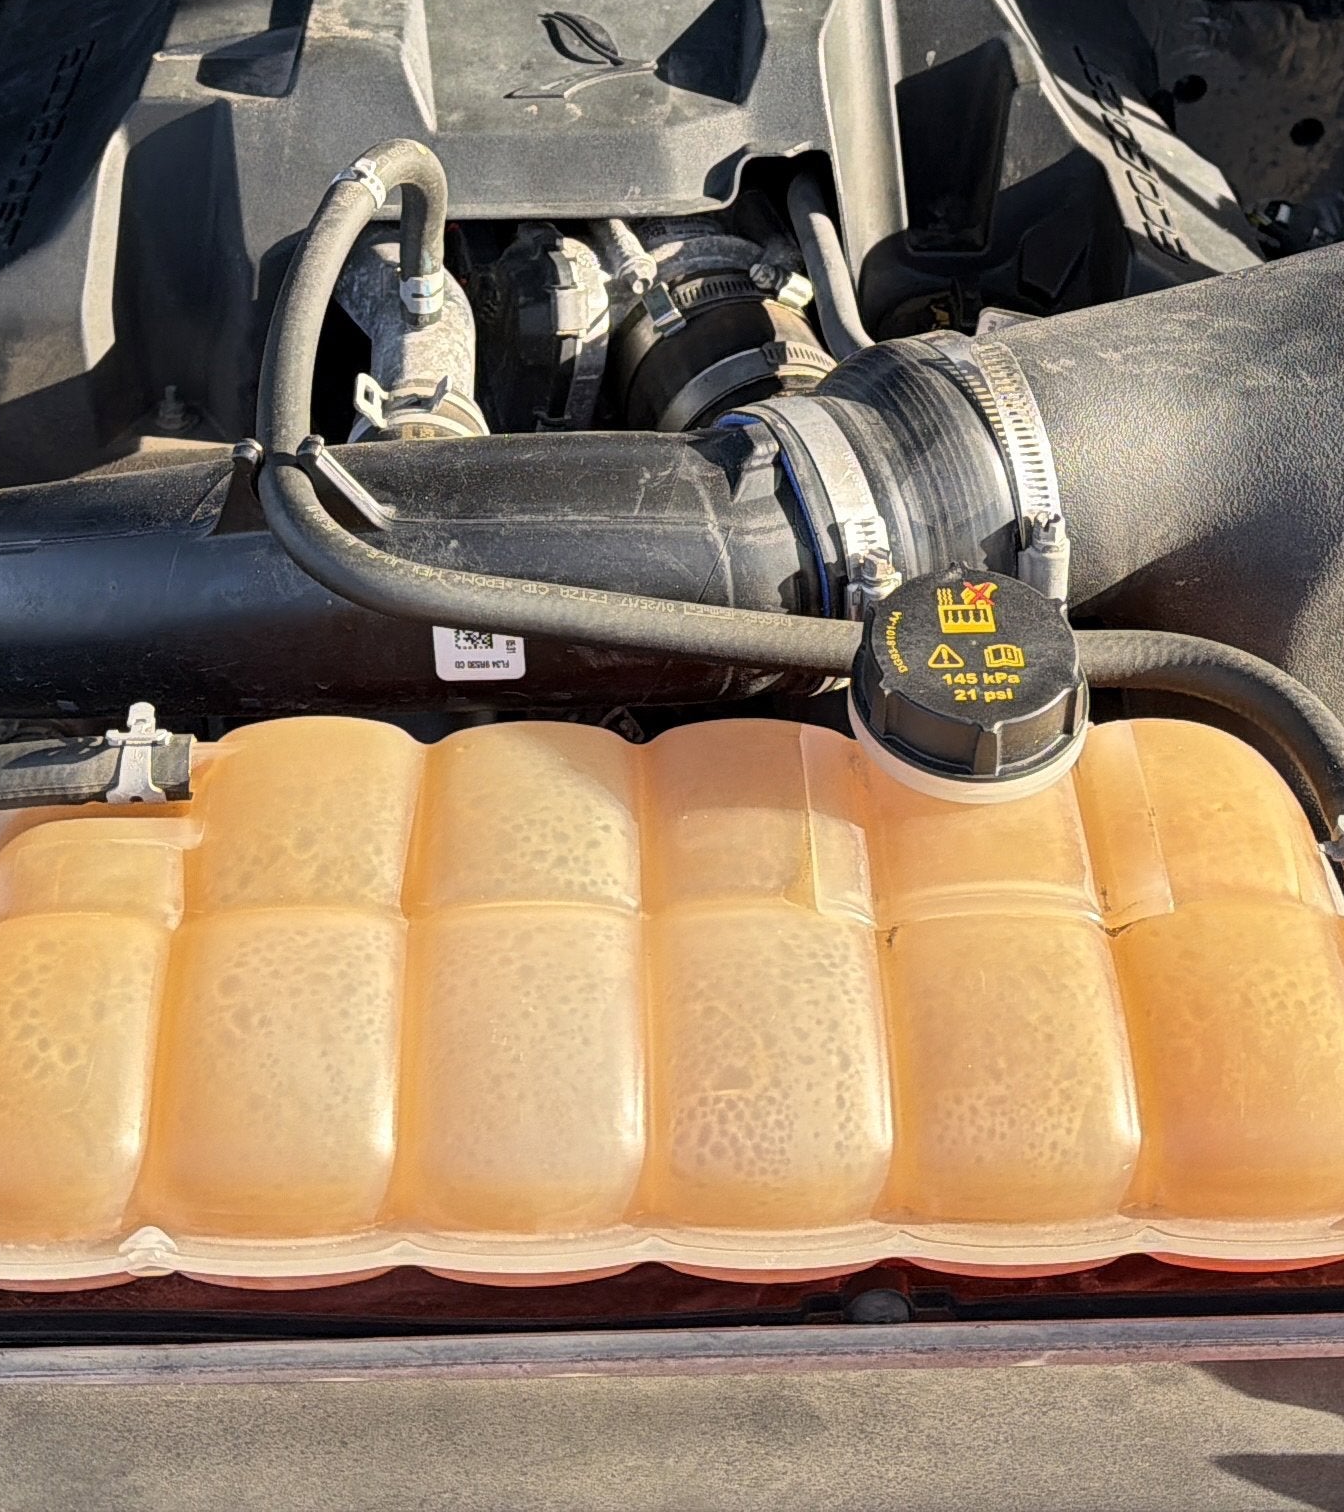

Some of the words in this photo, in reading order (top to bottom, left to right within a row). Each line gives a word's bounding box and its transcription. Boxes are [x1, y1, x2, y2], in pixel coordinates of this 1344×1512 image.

[942, 672, 979, 686] 145
[983, 671, 1021, 686] kPa
[953, 689, 977, 702] 21
[984, 688, 1014, 704] psi
